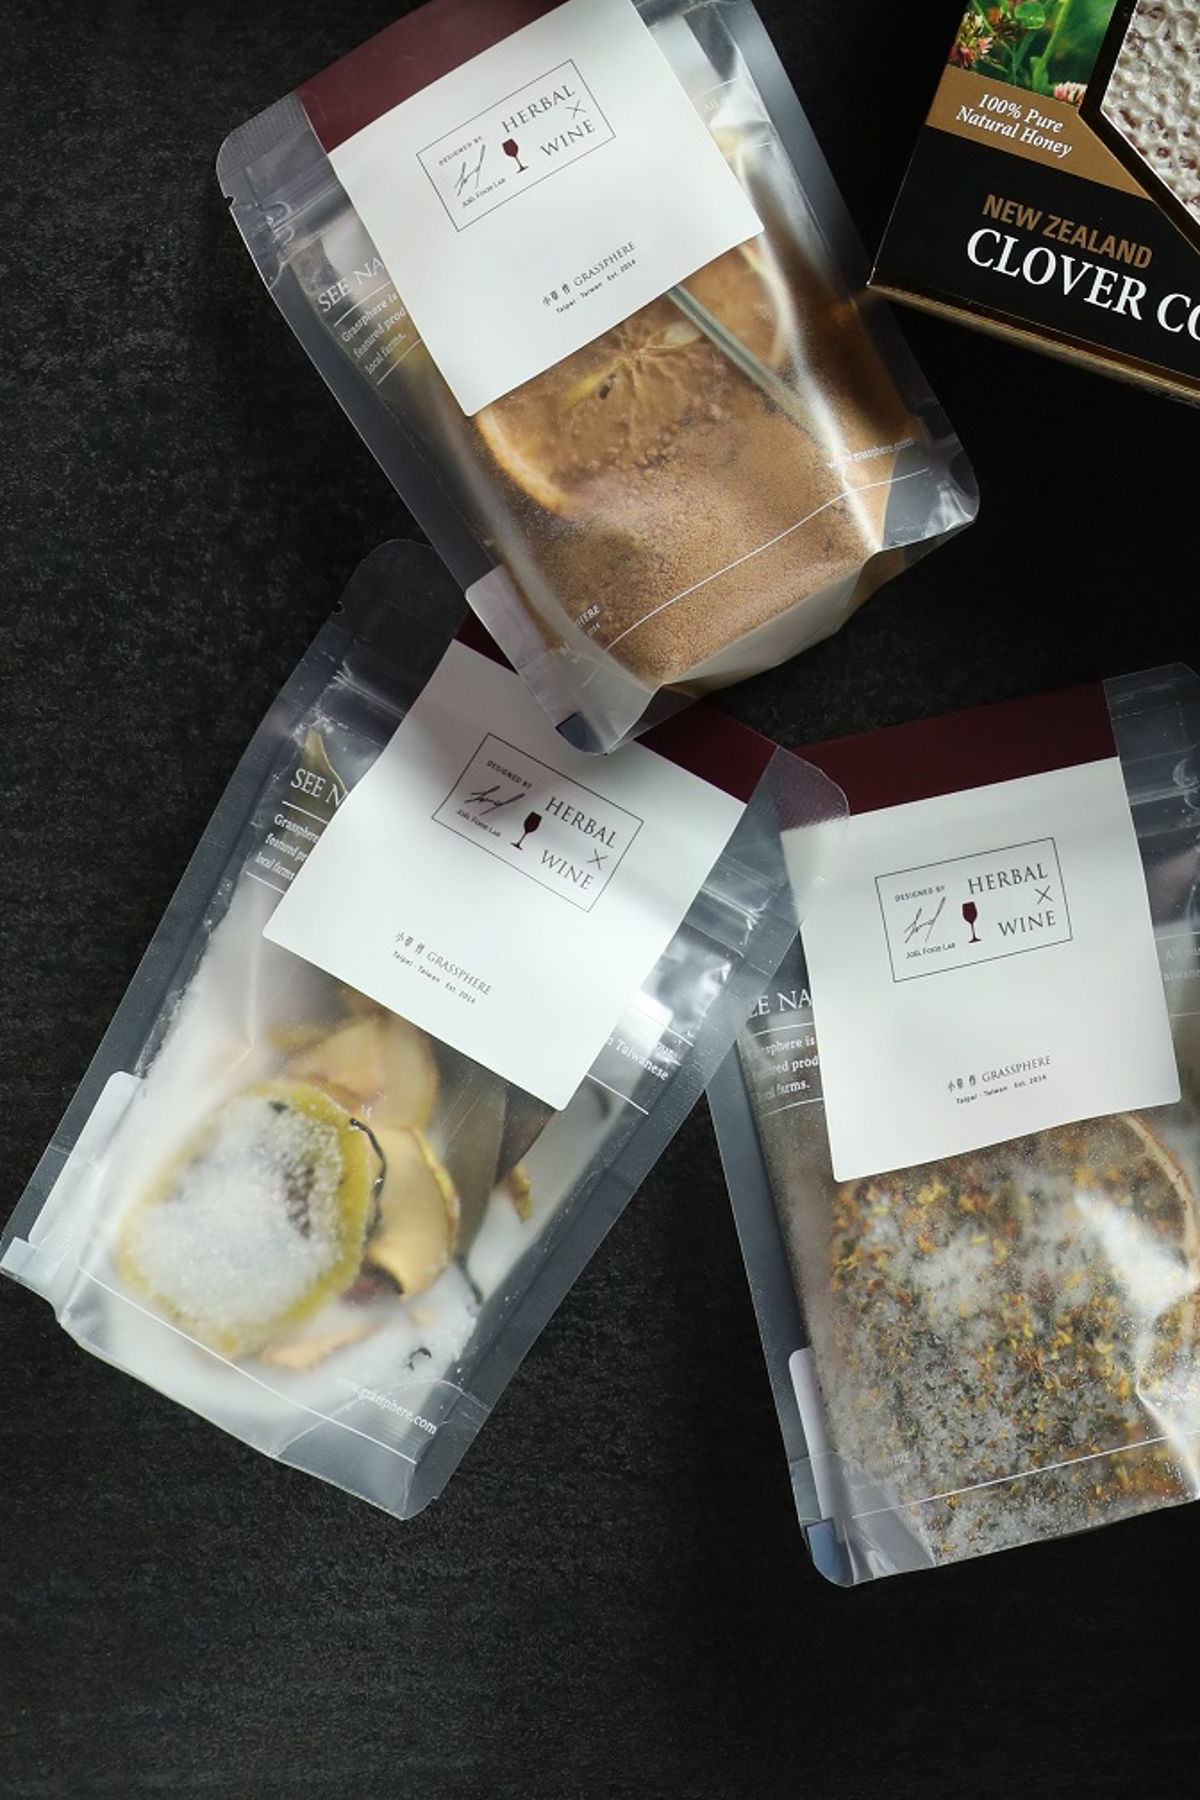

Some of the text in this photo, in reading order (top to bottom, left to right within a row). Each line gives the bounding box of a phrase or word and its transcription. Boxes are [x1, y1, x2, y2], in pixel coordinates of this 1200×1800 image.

[501, 80, 576, 134] HERBAL
[977, 92, 1064, 134] 100% Pure
[540, 117, 595, 159] WINE
[955, 105, 1072, 161] Natural Honey
[980, 193, 1154, 271] NEW ZEALAND
[963, 223, 1151, 320] CLOVER
[289, 767, 326, 798] SEE
[543, 795, 620, 849] HERBAL
[537, 848, 593, 890] WINE
[966, 862, 1048, 895] HERBAL
[997, 911, 1056, 937] WINE
